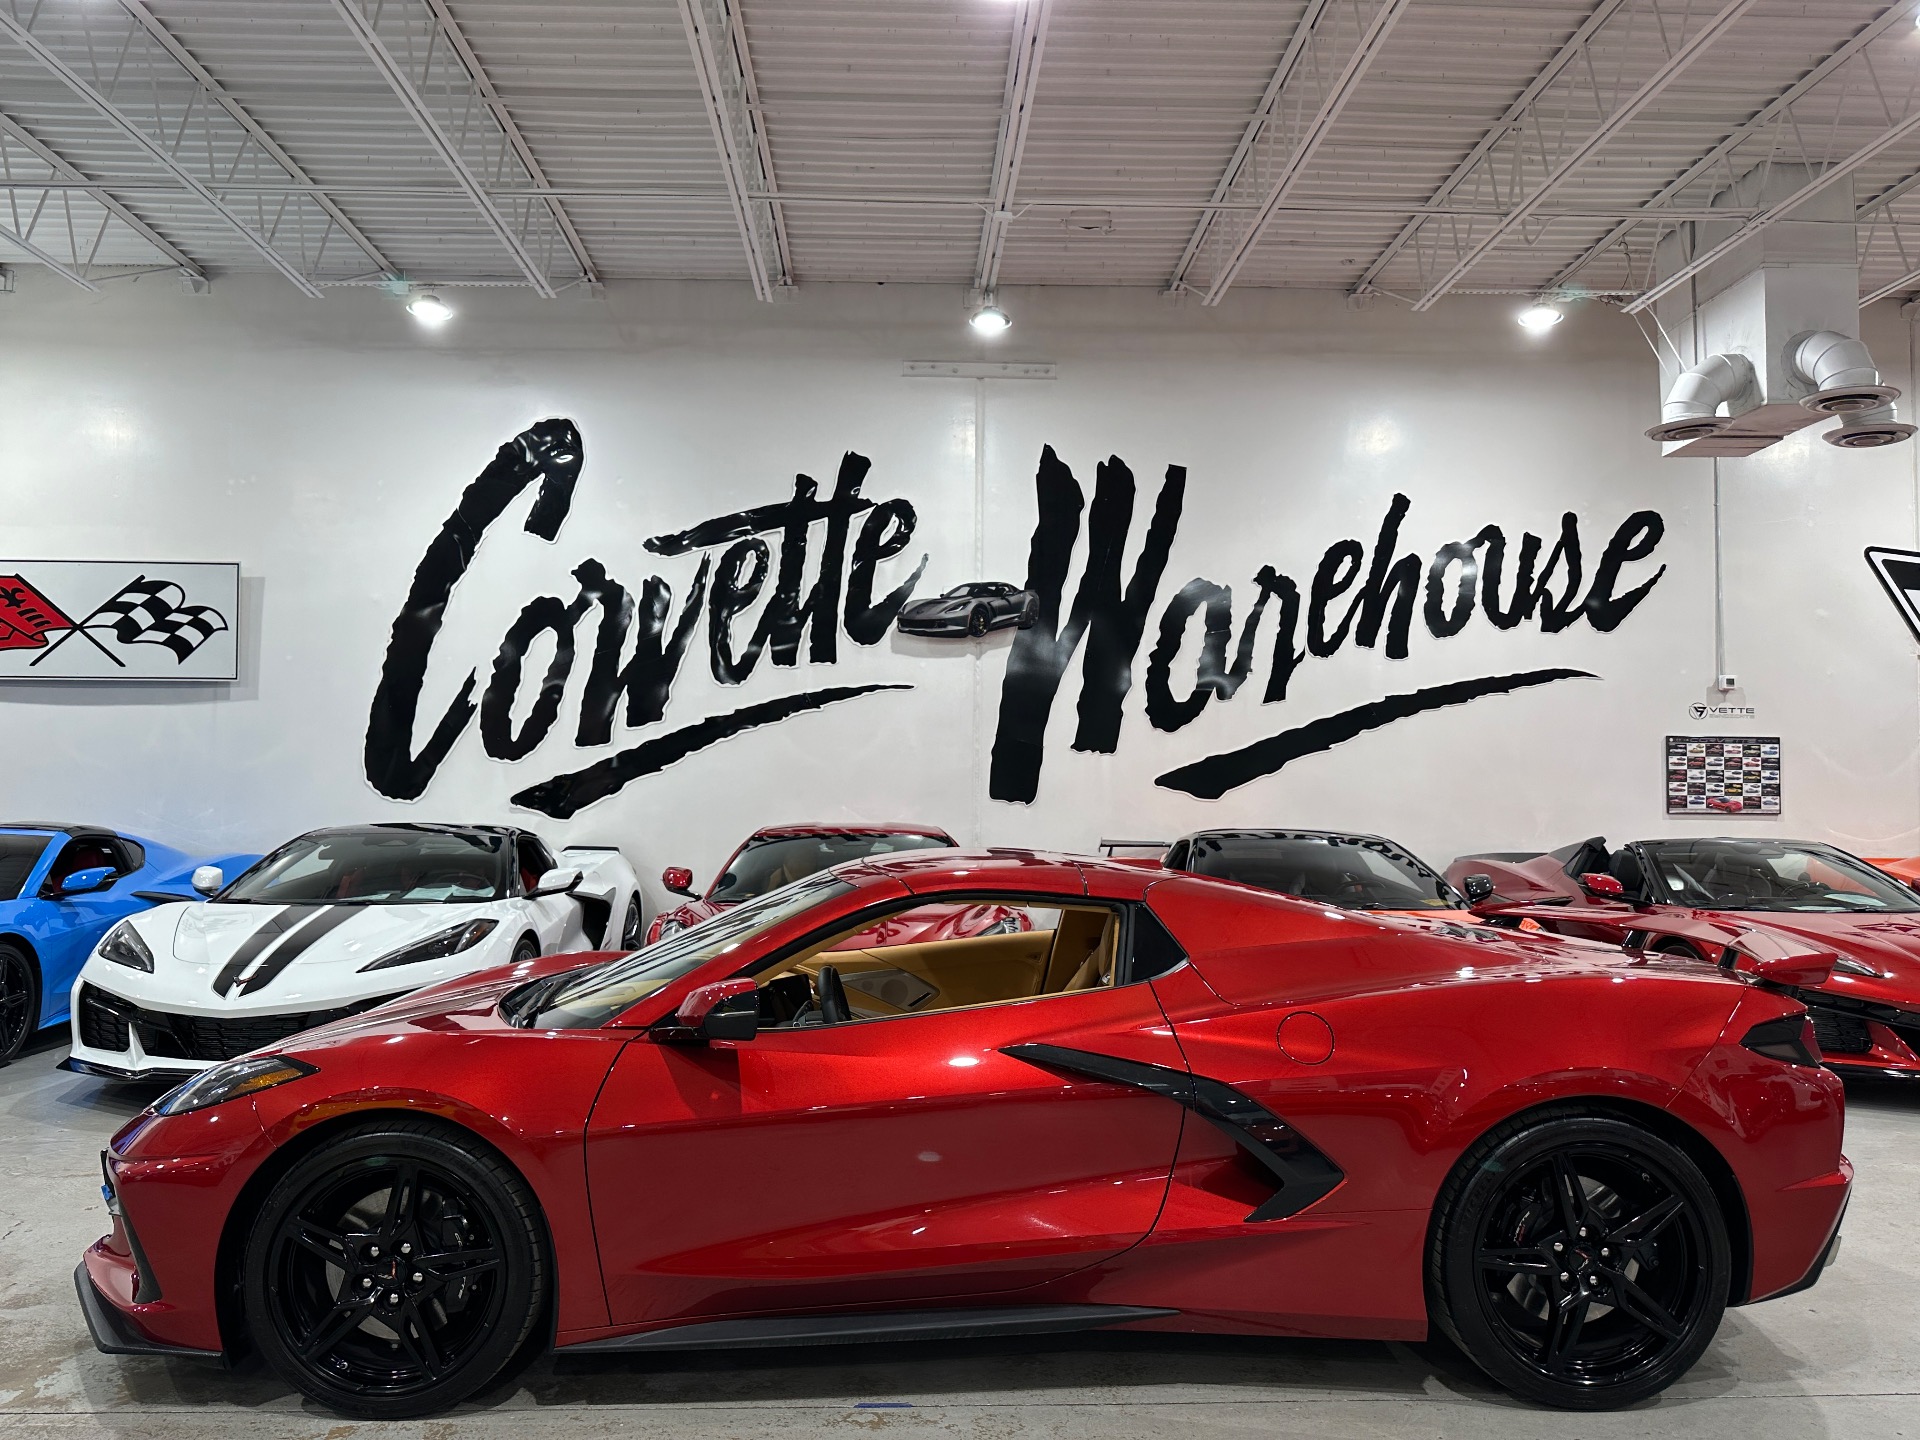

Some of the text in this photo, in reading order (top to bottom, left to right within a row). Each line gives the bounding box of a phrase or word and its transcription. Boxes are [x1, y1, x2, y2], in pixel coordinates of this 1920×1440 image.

[365, 417, 1667, 804] Corvette Warehouse
[1708, 706, 1755, 714] VETTE
